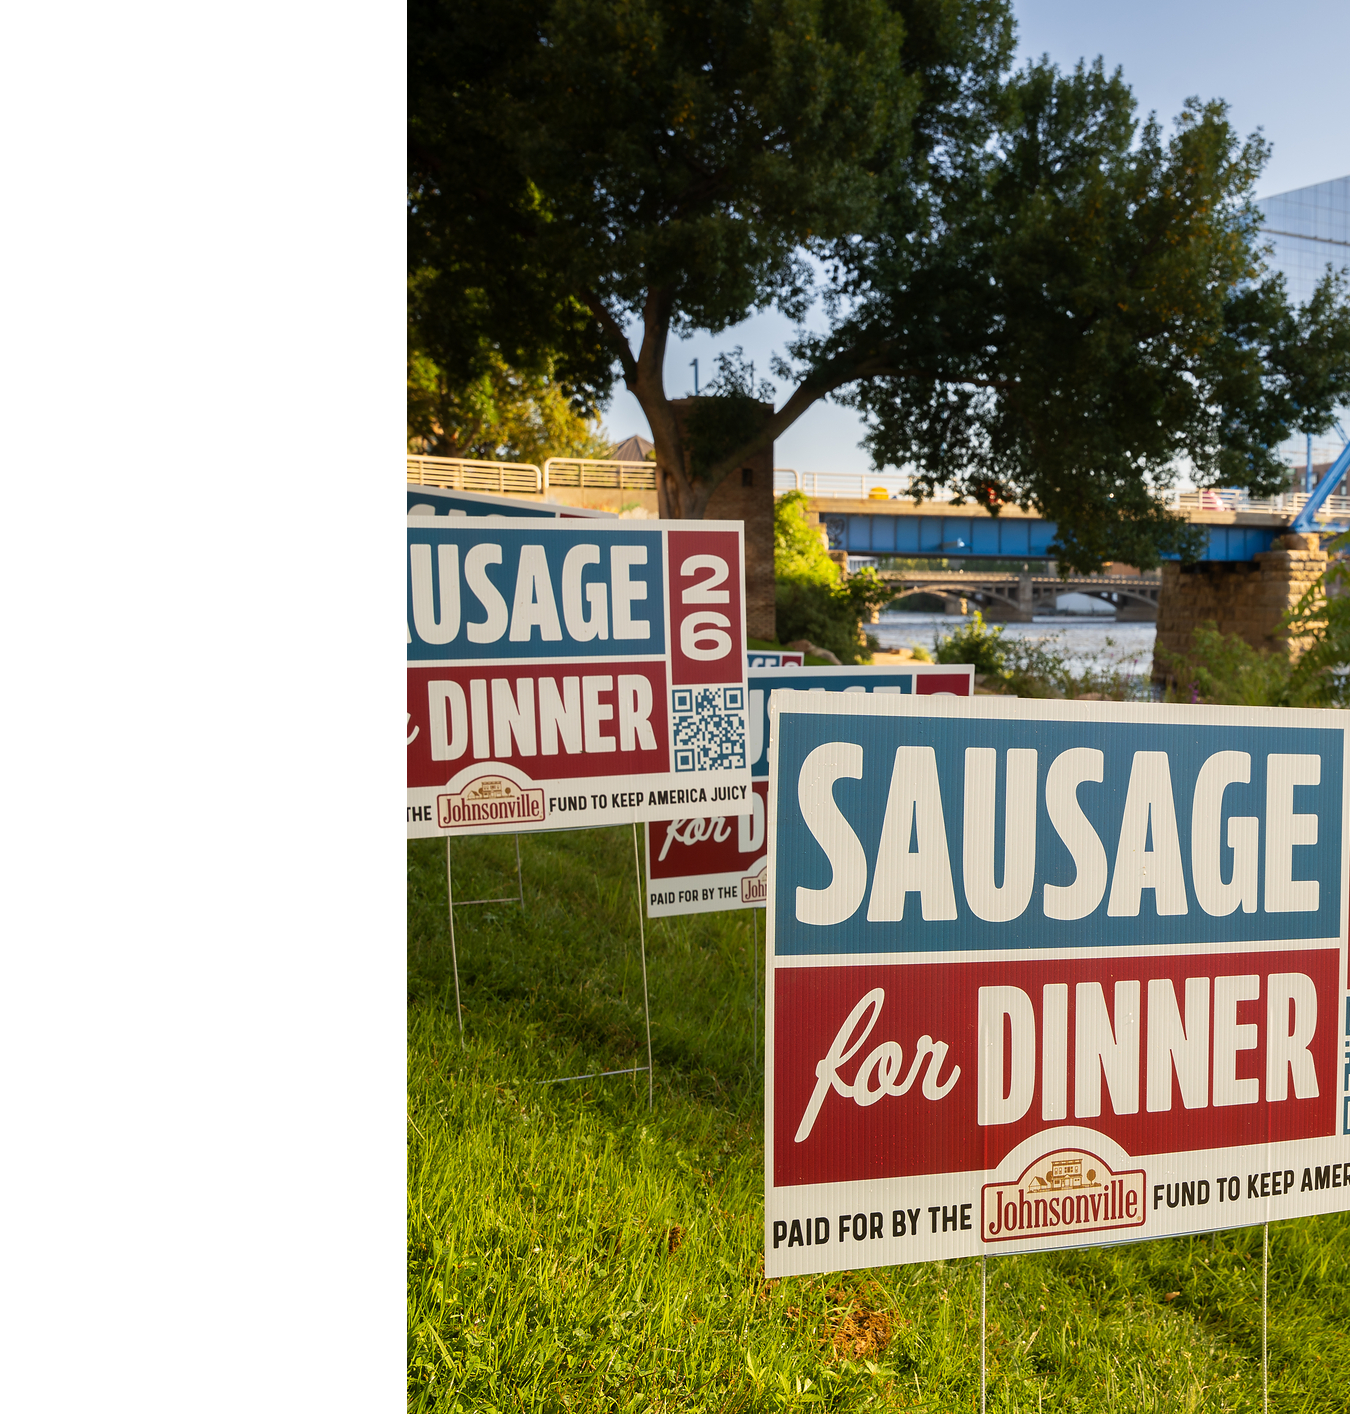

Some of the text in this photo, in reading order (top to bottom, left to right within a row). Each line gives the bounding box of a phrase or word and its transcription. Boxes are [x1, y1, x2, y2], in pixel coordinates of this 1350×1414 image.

[407, 543, 650, 644] USAGE
[428, 674, 657, 762] DINNER
[443, 793, 540, 824] Johnsonville
[549, 796, 587, 813] FUND
[590, 794, 608, 810] TO
[611, 791, 644, 809] KEEP
[648, 787, 707, 806] AMERICA
[710, 785, 748, 802] JUICY
[796, 742, 1321, 926] SAUSAGE
[650, 892, 676, 907] PAID
[678, 889, 699, 904] FOR
[701, 887, 715, 901] BY
[716, 885, 738, 900] THE
[794, 973, 1320, 1143] for DINNER
[773, 1220, 830, 1249] PAID
[838, 1211, 884, 1243] FOR
[892, 1207, 921, 1238] BY
[927, 1203, 973, 1234] THE
[988, 1179, 1138, 1235] Johnsonville
[1153, 1179, 1210, 1210] FUND
[1216, 1175, 1241, 1203] TO
[1247, 1169, 1295, 1199] KEEP
